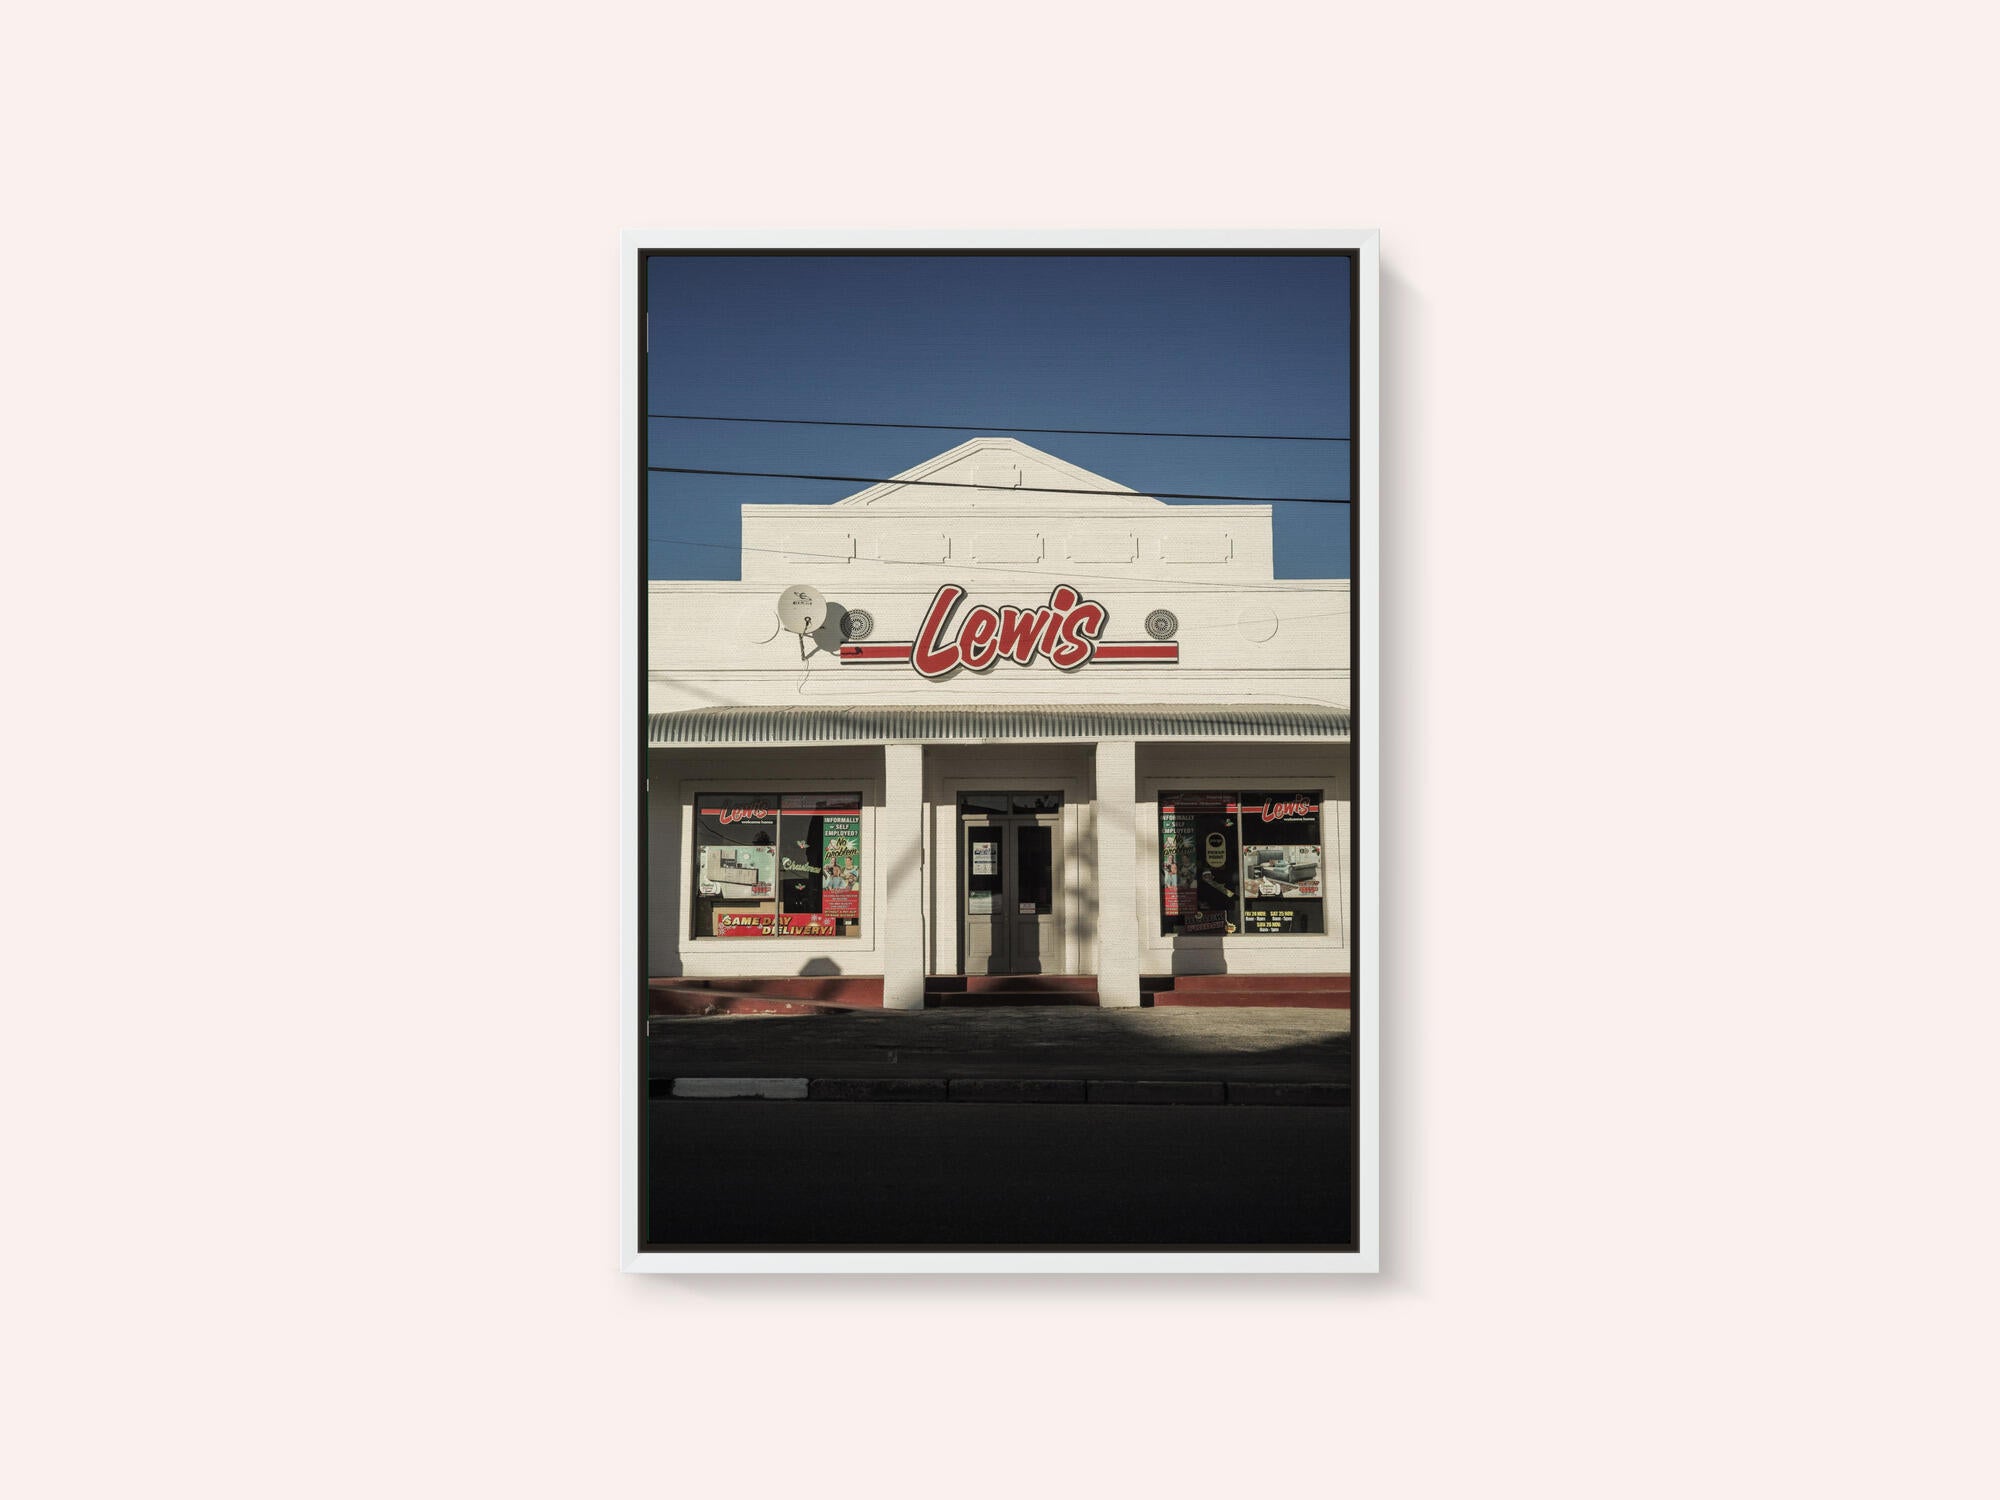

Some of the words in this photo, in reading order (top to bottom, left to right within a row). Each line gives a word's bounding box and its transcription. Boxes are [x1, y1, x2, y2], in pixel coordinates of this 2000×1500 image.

[911, 584, 1109, 678] Lewis
[720, 799, 769, 825] Lewis
[1262, 795, 1310, 822] Lewis
[836, 836, 847, 847] No
[723, 915, 760, 926] SAME
[763, 917, 792, 926] DAY
[762, 926, 834, 936] DELIVERY!
